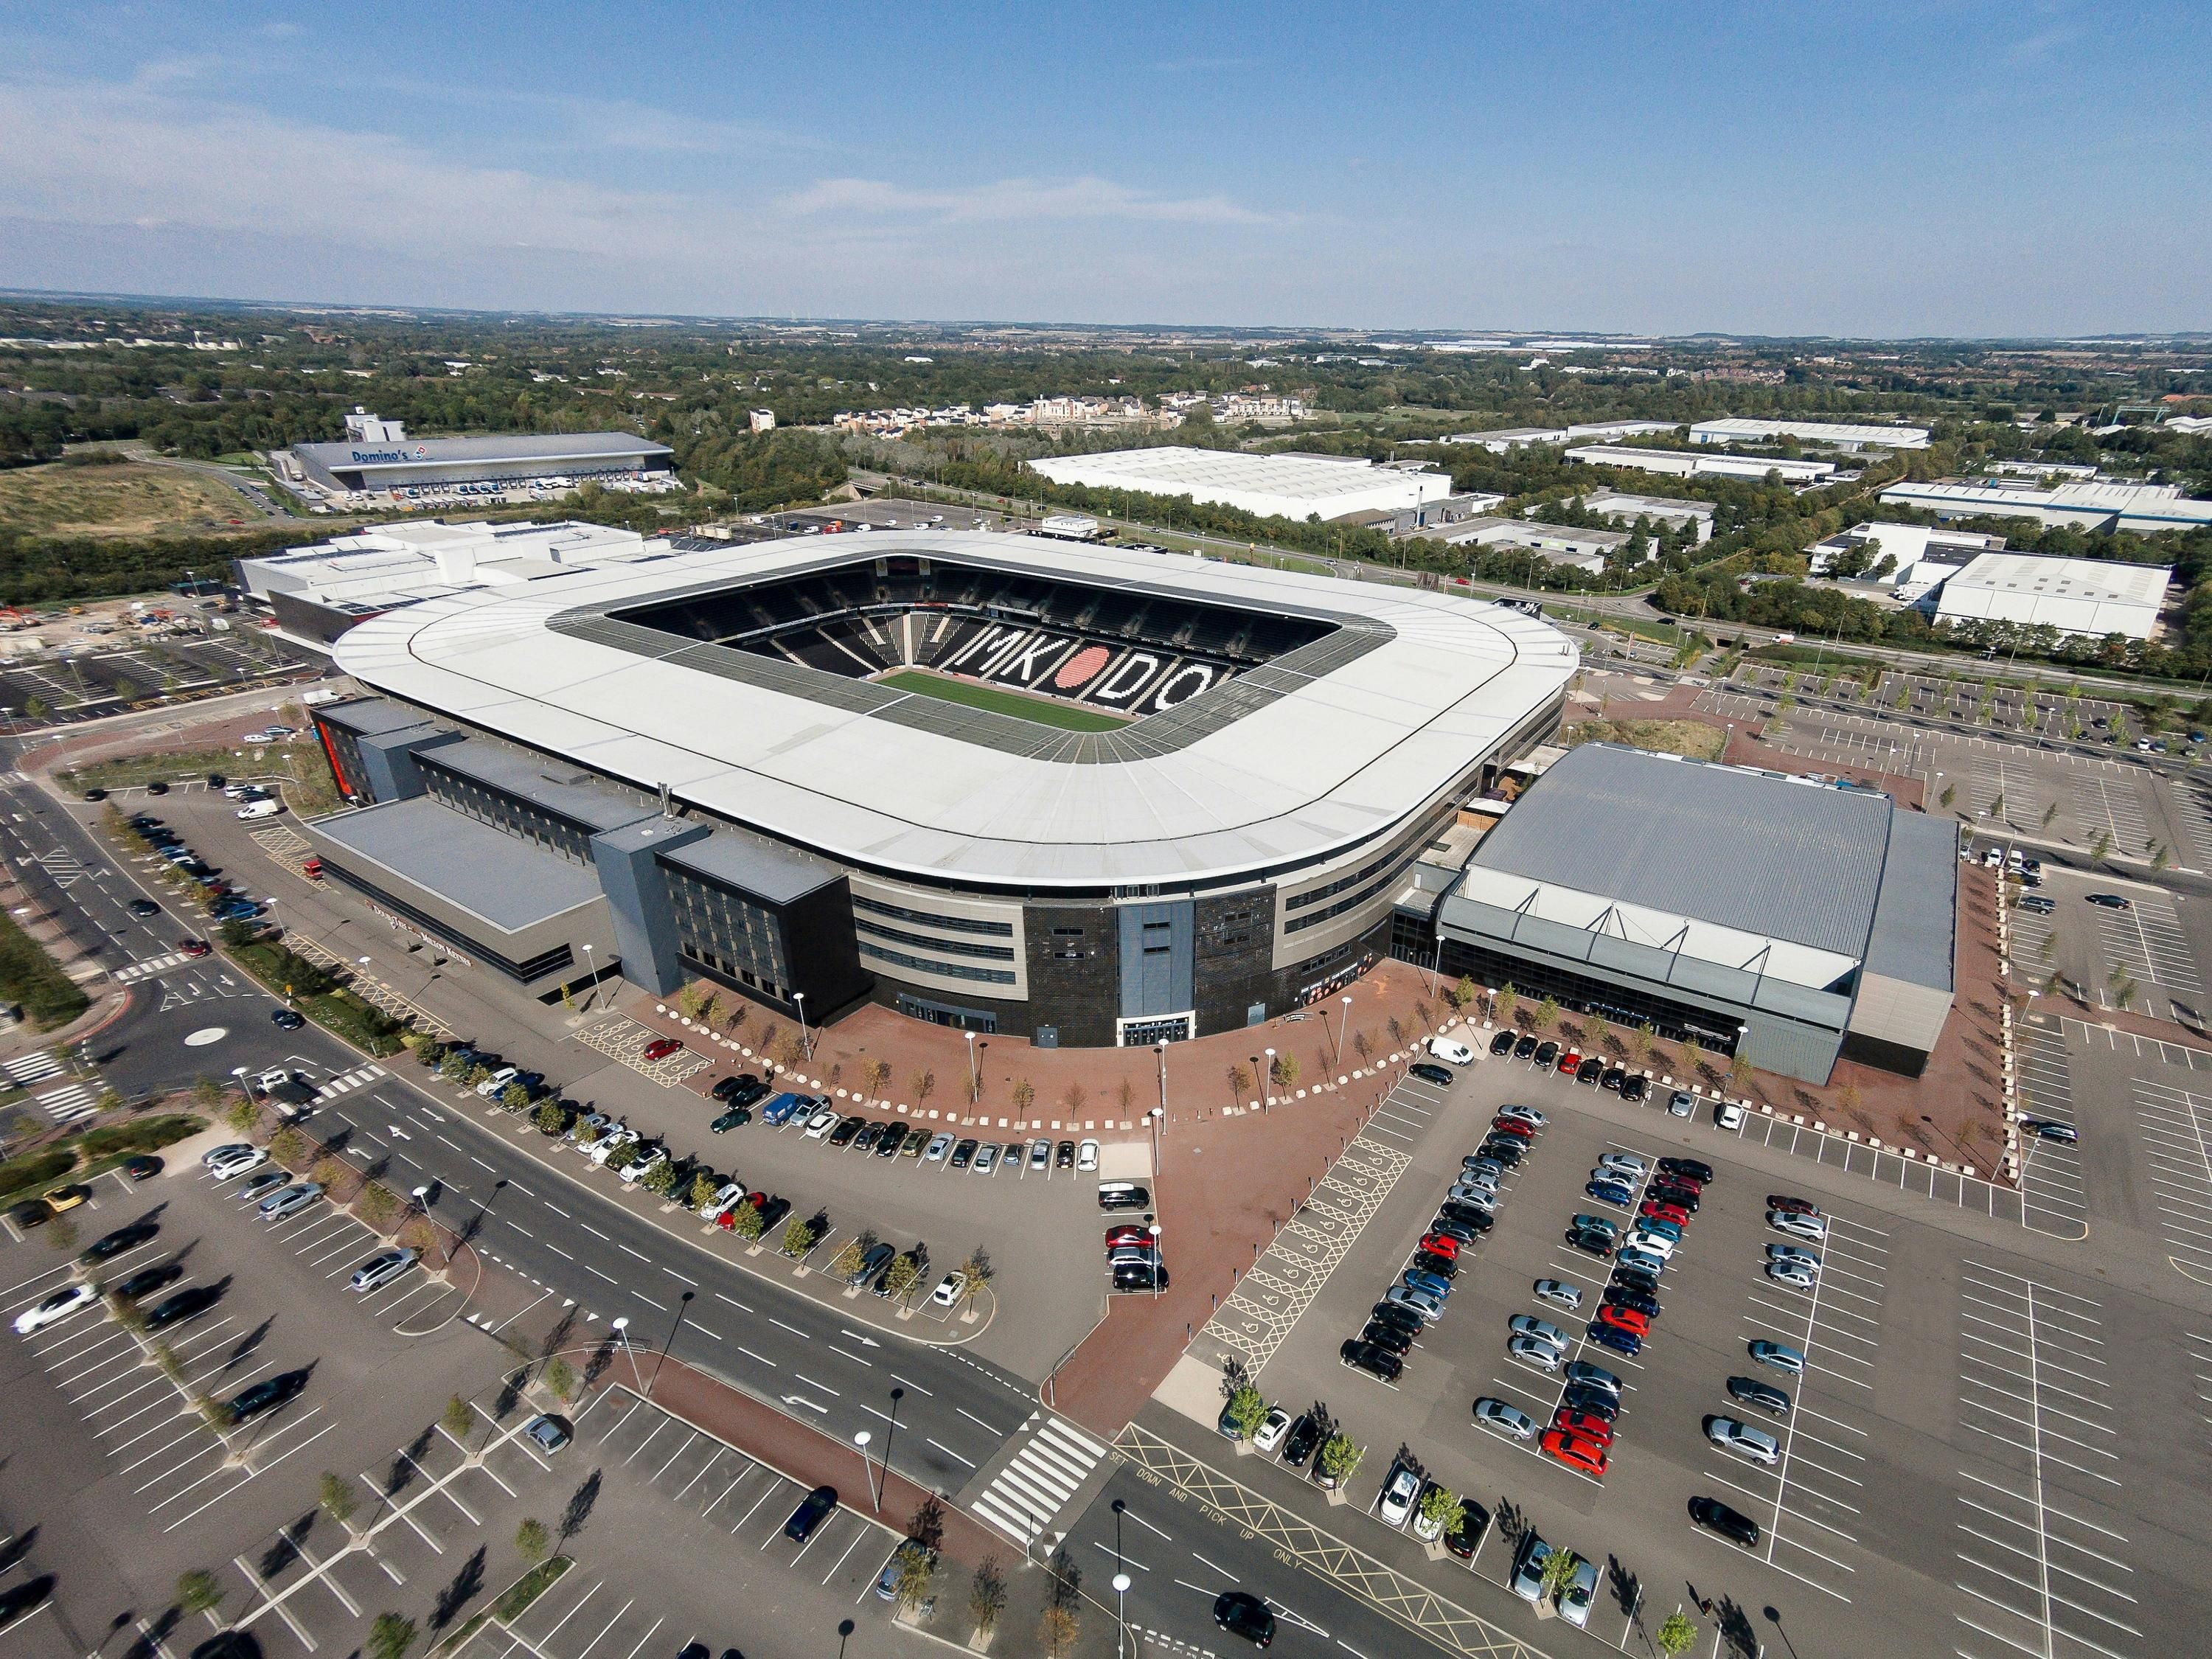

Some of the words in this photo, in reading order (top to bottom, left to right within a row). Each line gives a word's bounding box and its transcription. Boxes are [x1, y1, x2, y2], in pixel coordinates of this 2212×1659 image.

[352, 450, 408, 462] Domino's
[955, 626, 1070, 681] MK
[1109, 1452, 1128, 1466] SET
[1135, 1468, 1162, 1487] DOWN
[1168, 1487, 1188, 1503] AND
[1198, 1505, 1228, 1526] PICK
[1239, 1528, 1254, 1540] UP
[1273, 1548, 1302, 1570] ONLY
